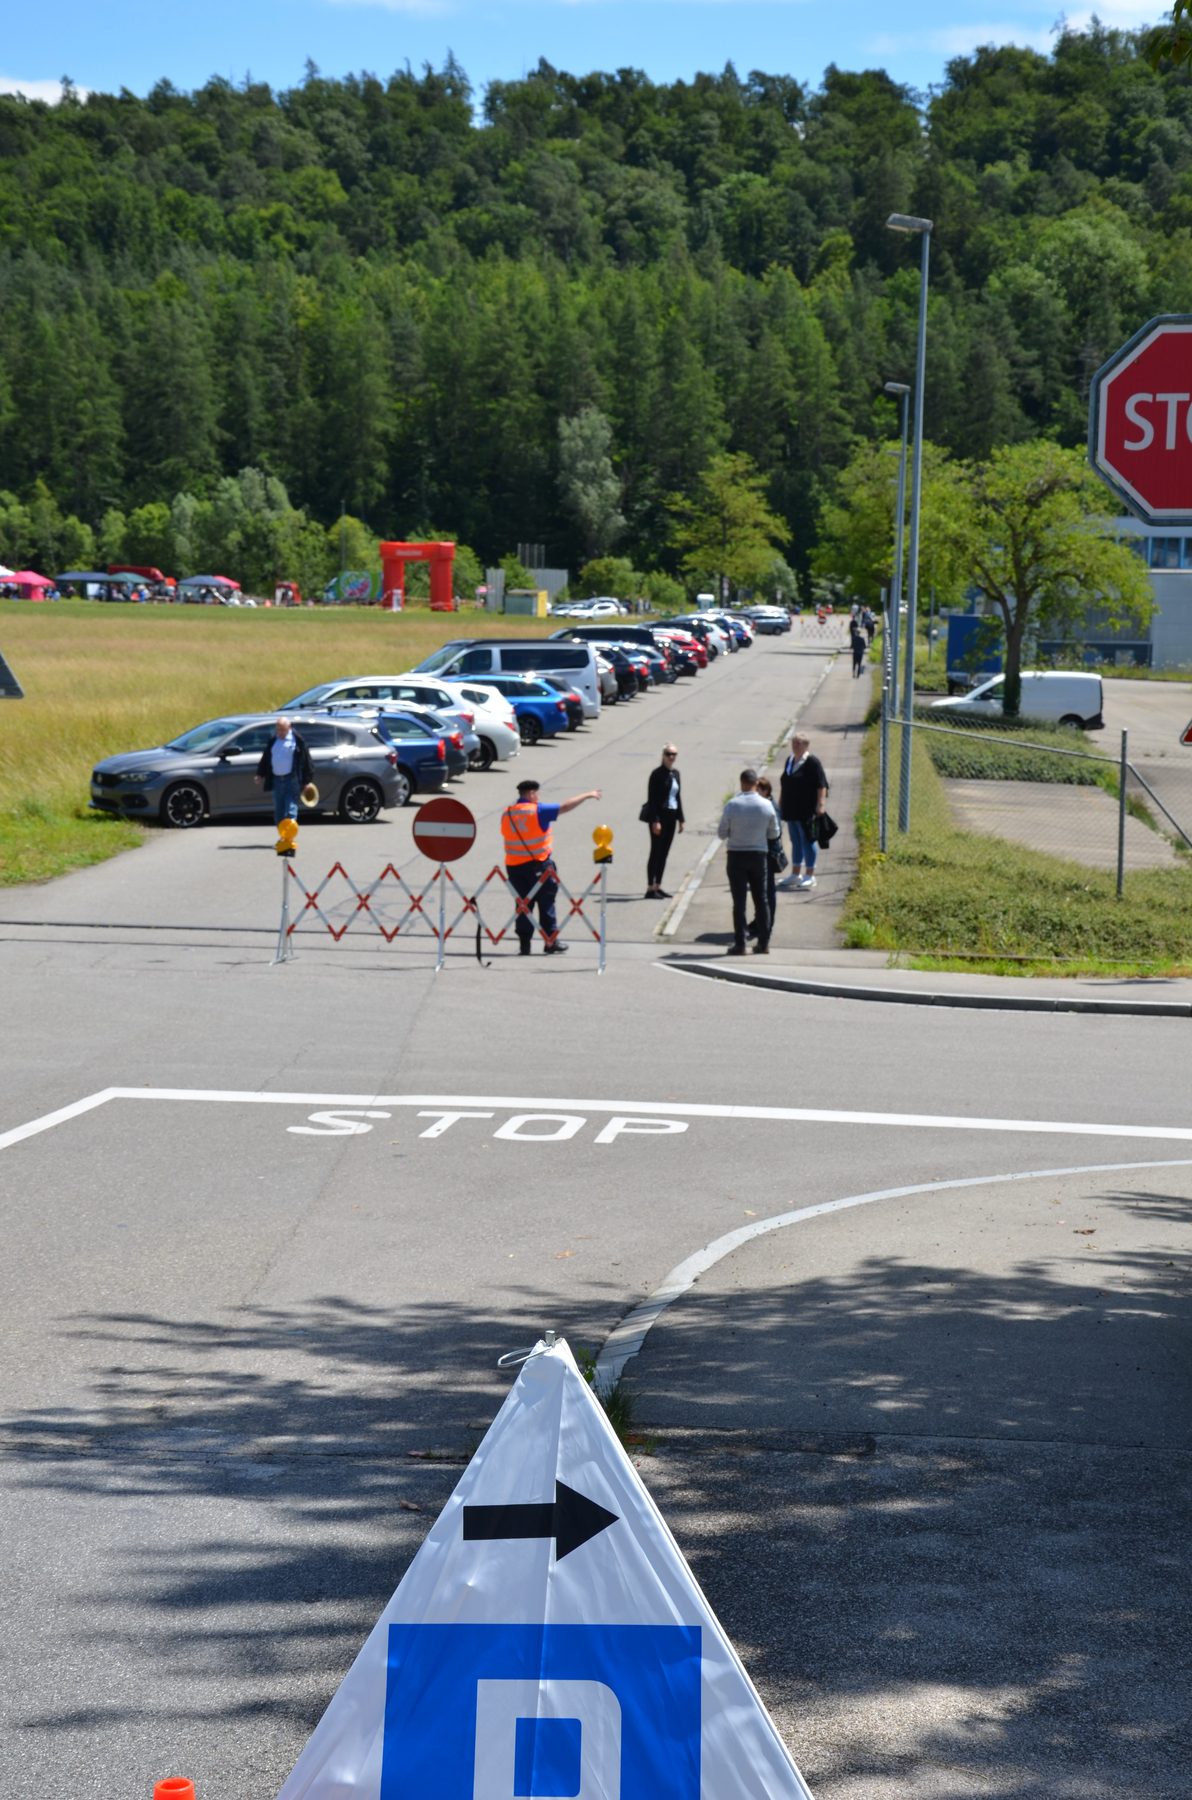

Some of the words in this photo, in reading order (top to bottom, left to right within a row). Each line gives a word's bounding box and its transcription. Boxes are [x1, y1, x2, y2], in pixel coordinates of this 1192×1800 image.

[1123, 392, 1192, 451] ST
[286, 1110, 689, 1144] STOP
[473, 1680, 622, 1800] P
